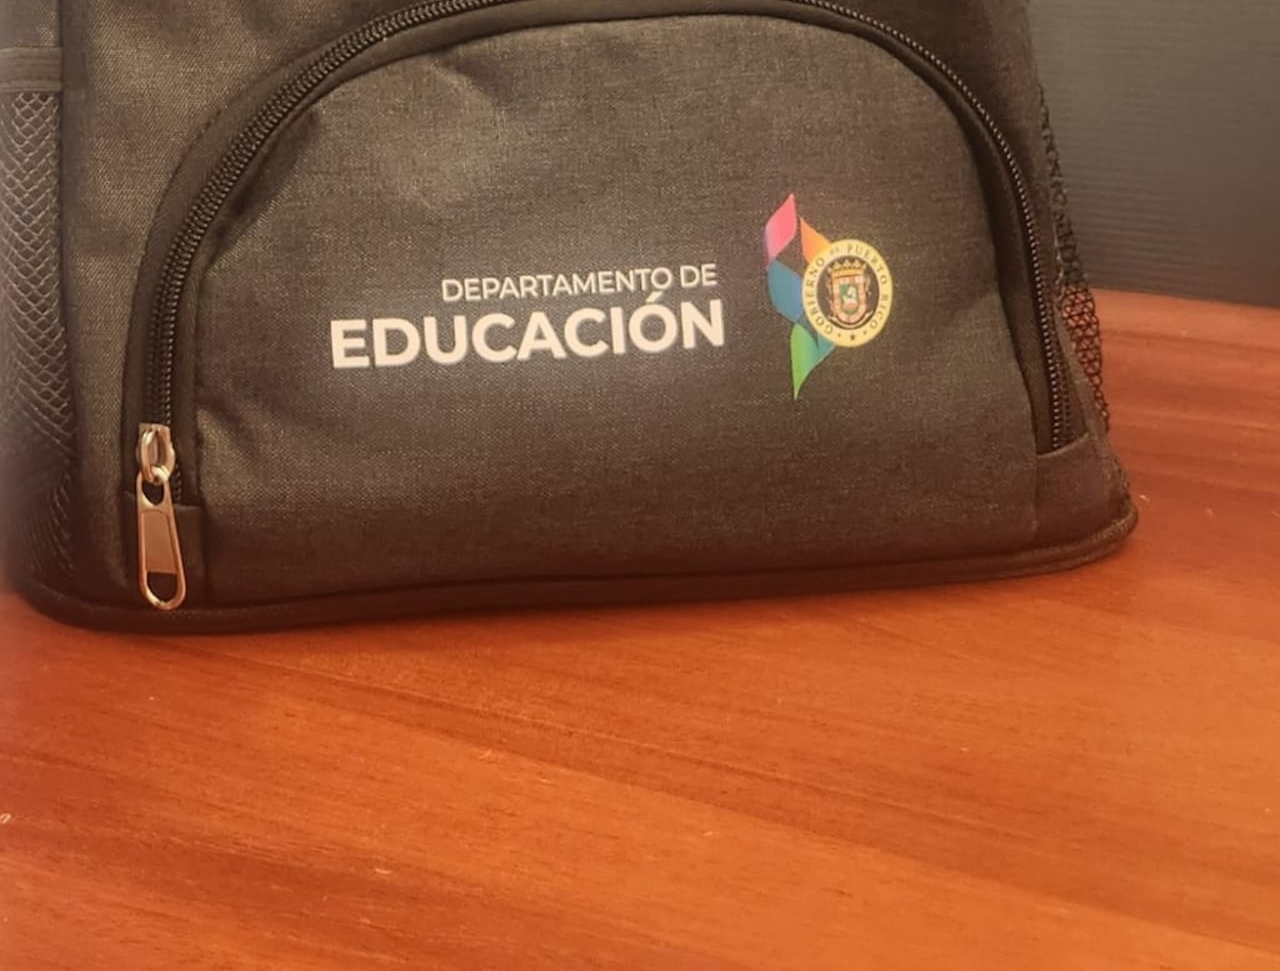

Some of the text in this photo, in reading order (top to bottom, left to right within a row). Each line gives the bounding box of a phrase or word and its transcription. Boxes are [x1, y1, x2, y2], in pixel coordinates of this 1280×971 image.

[441, 263, 718, 302] DEPARTAMENTO DE
[329, 291, 725, 369] EDUCACIÓN
